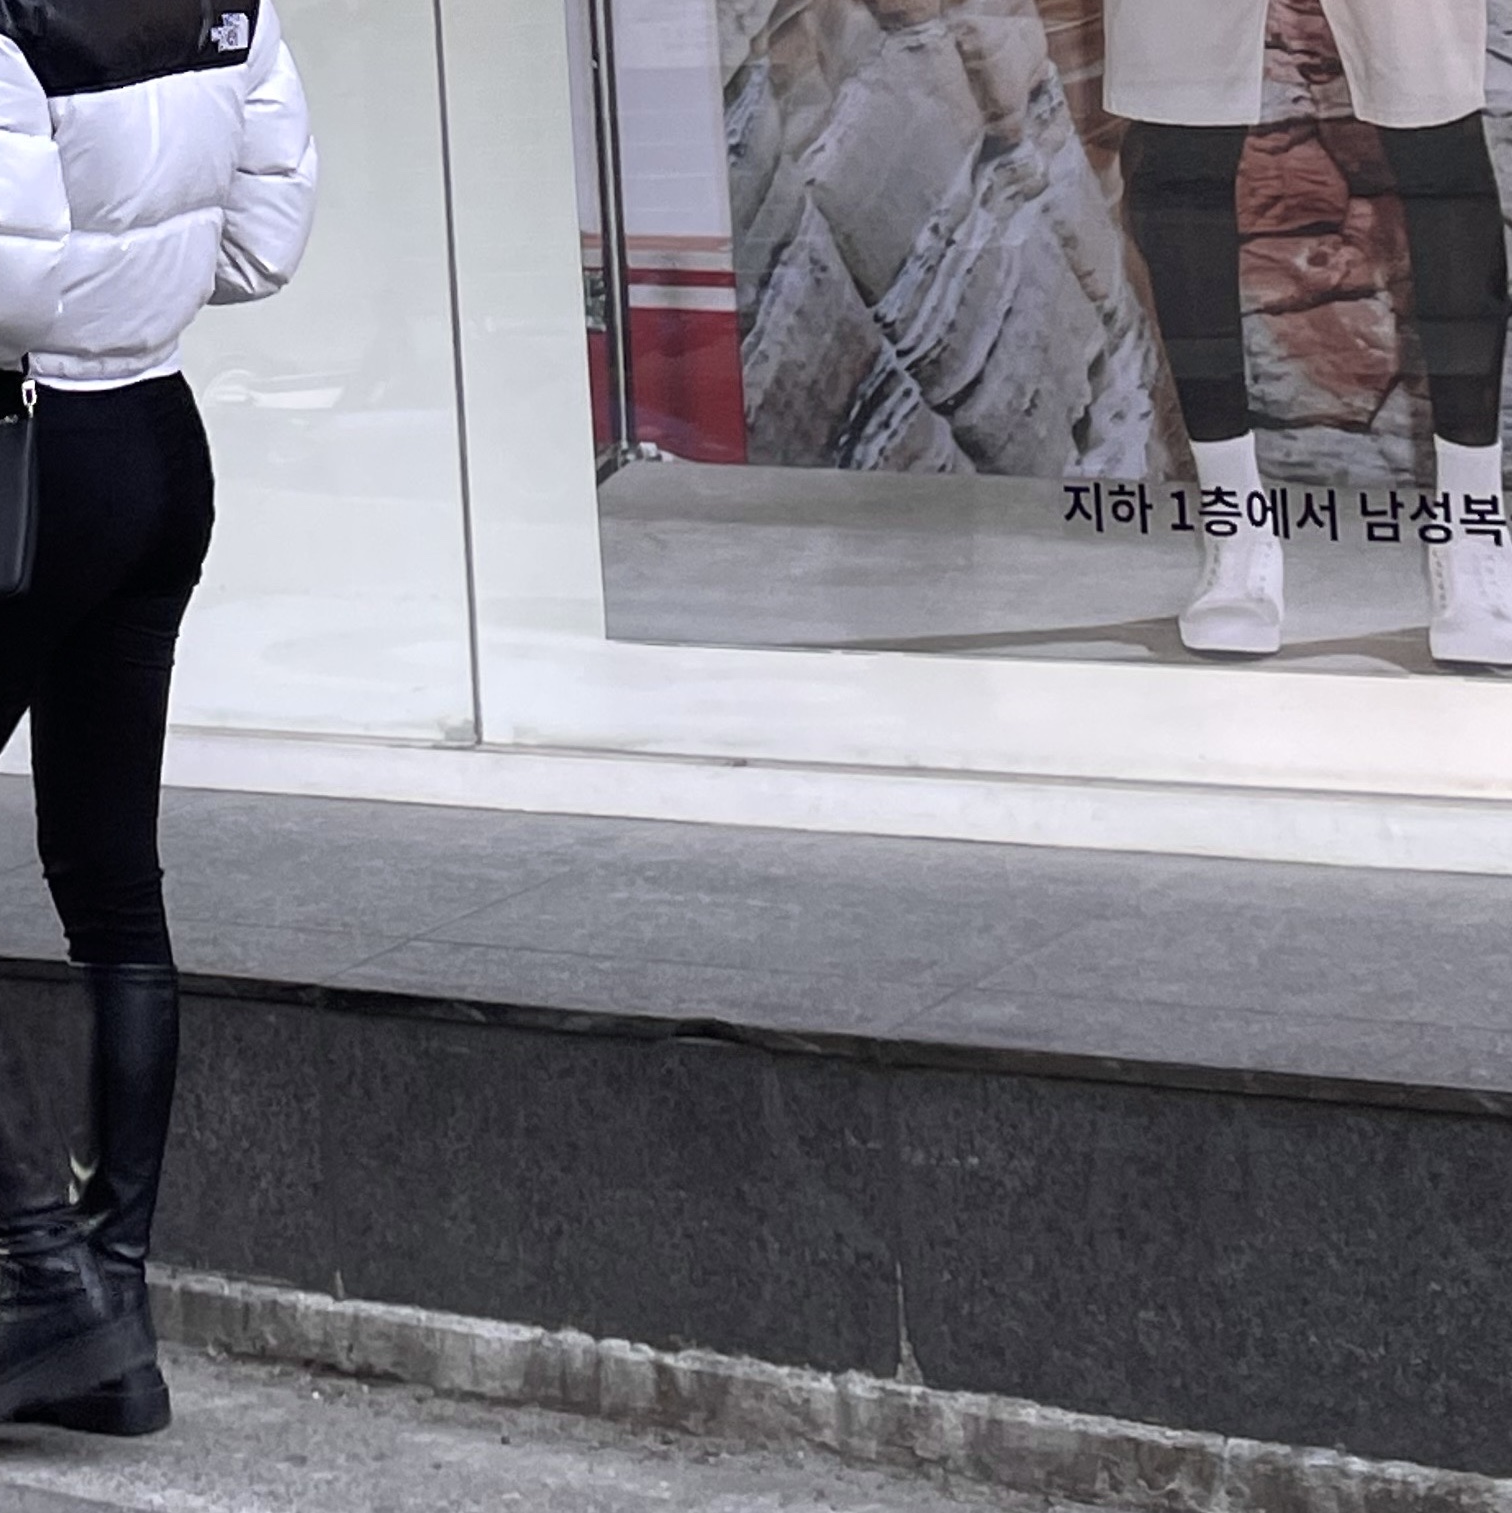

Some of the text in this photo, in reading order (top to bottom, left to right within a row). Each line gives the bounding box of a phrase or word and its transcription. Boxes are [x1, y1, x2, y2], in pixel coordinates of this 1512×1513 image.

[1063, 482, 1512, 547] 지하 1층에서 남성복
